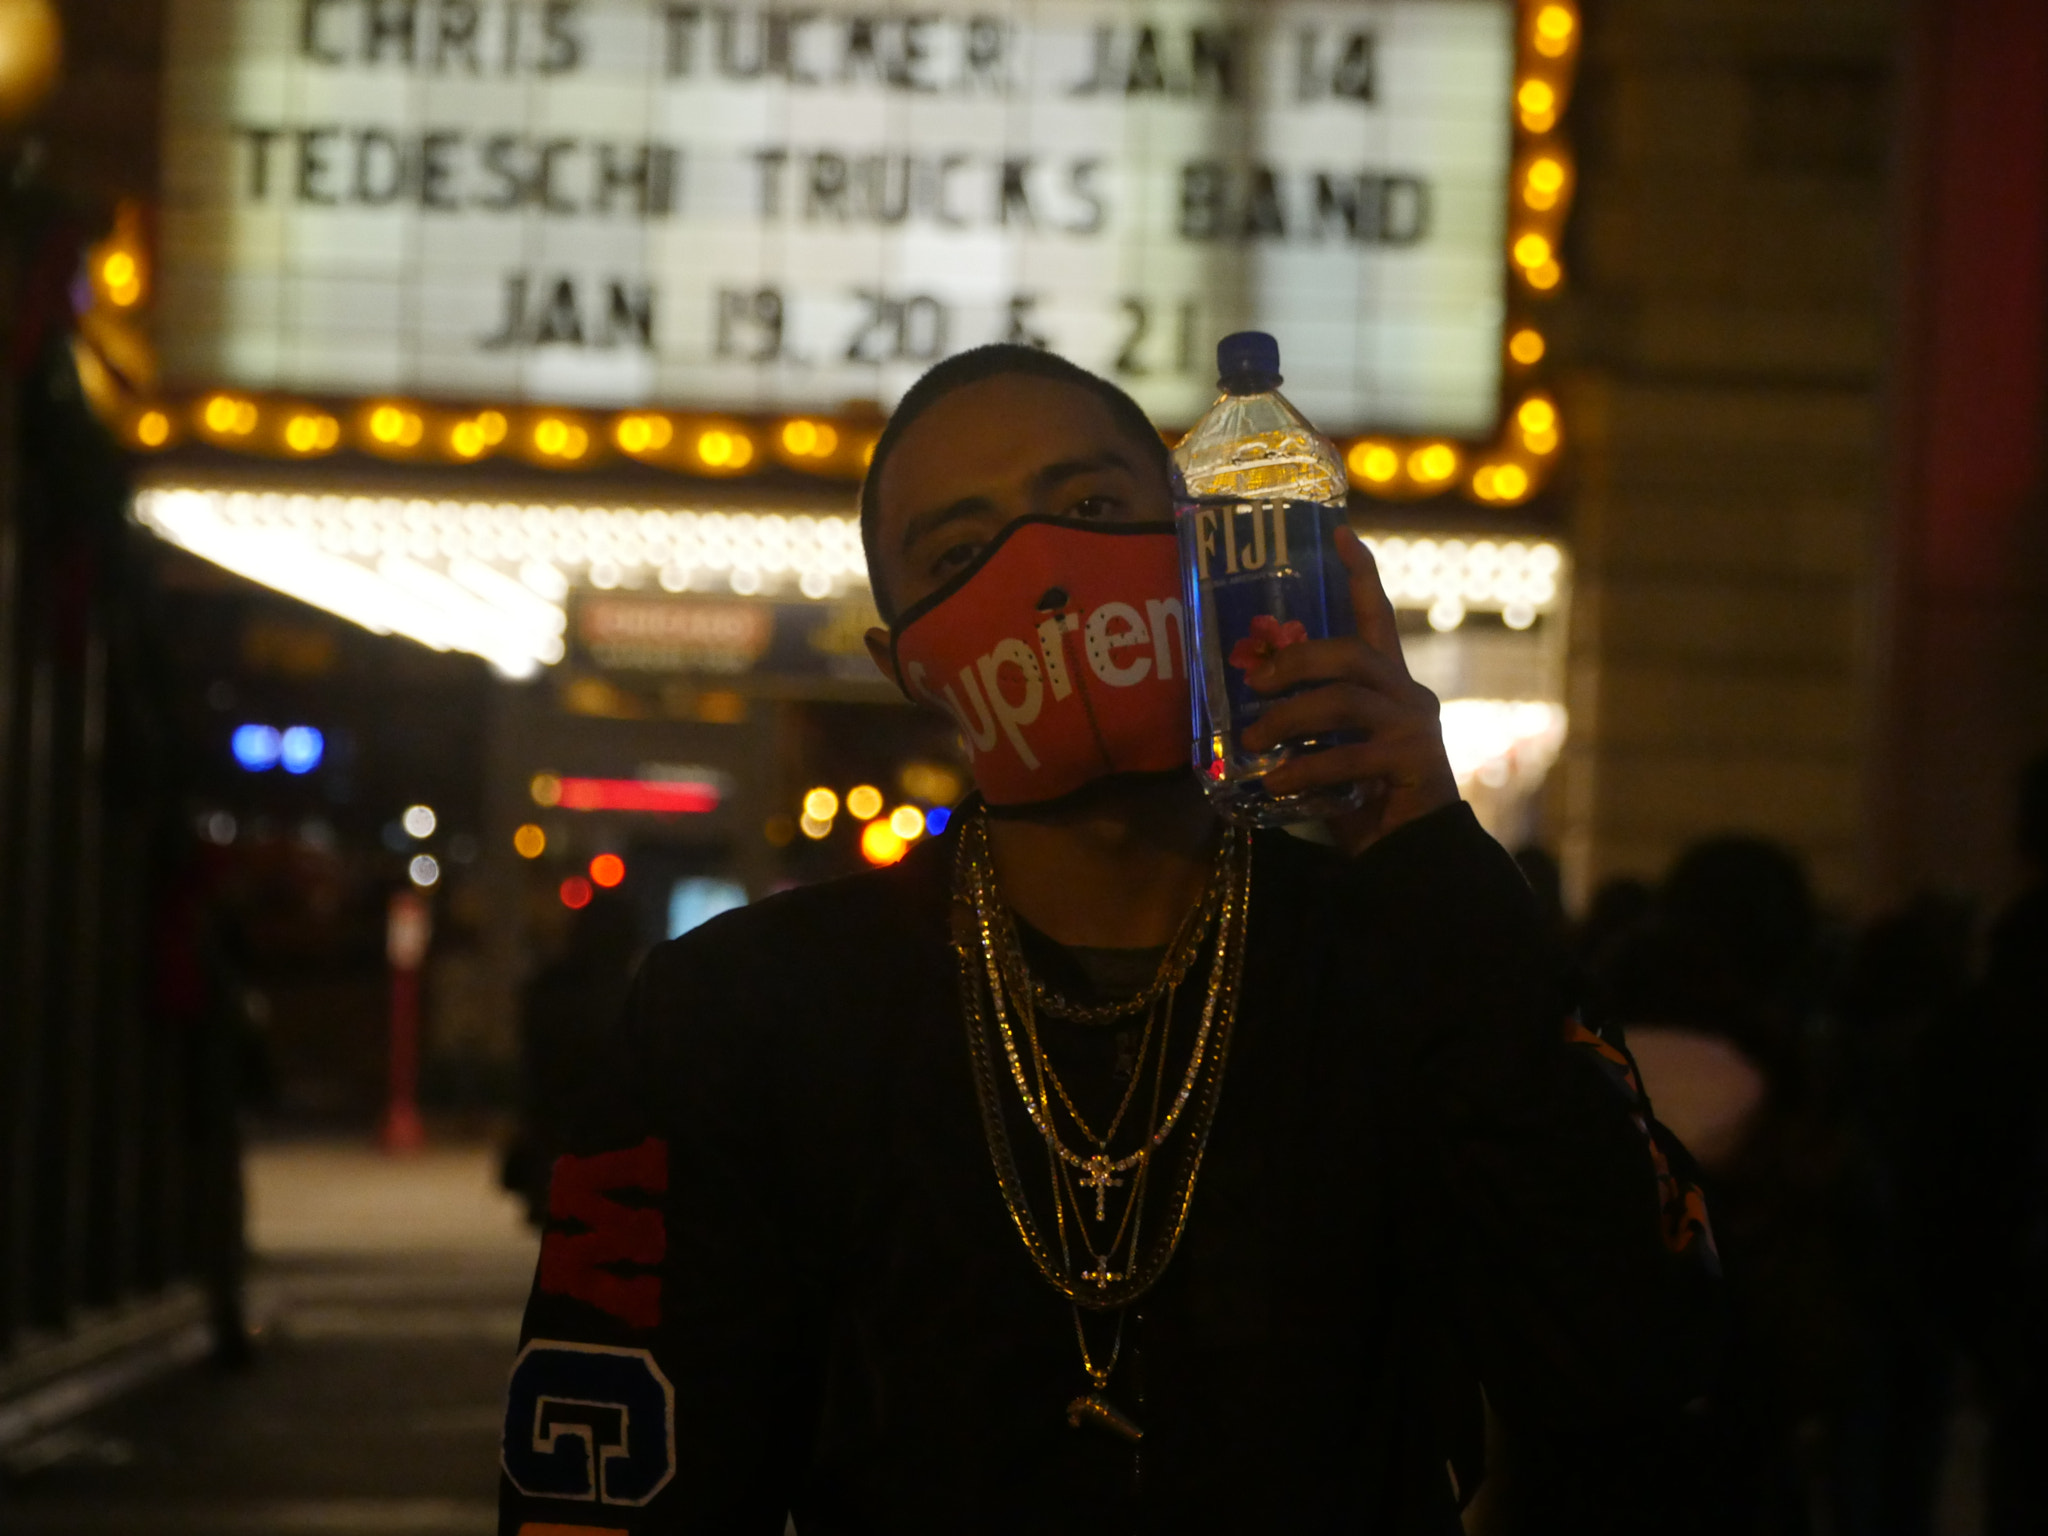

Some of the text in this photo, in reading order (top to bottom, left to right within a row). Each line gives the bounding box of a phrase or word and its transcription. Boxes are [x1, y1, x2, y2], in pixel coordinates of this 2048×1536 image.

[298, 0, 1378, 102] CHRIS TUCKER JAN 14
[240, 126, 1434, 248] TEDESCHI TRUCKS BAND
[482, 274, 654, 350] JAN
[846, 292, 946, 362] 20
[1114, 302, 1196, 374] 21
[1194, 500, 1291, 581] FIJI
